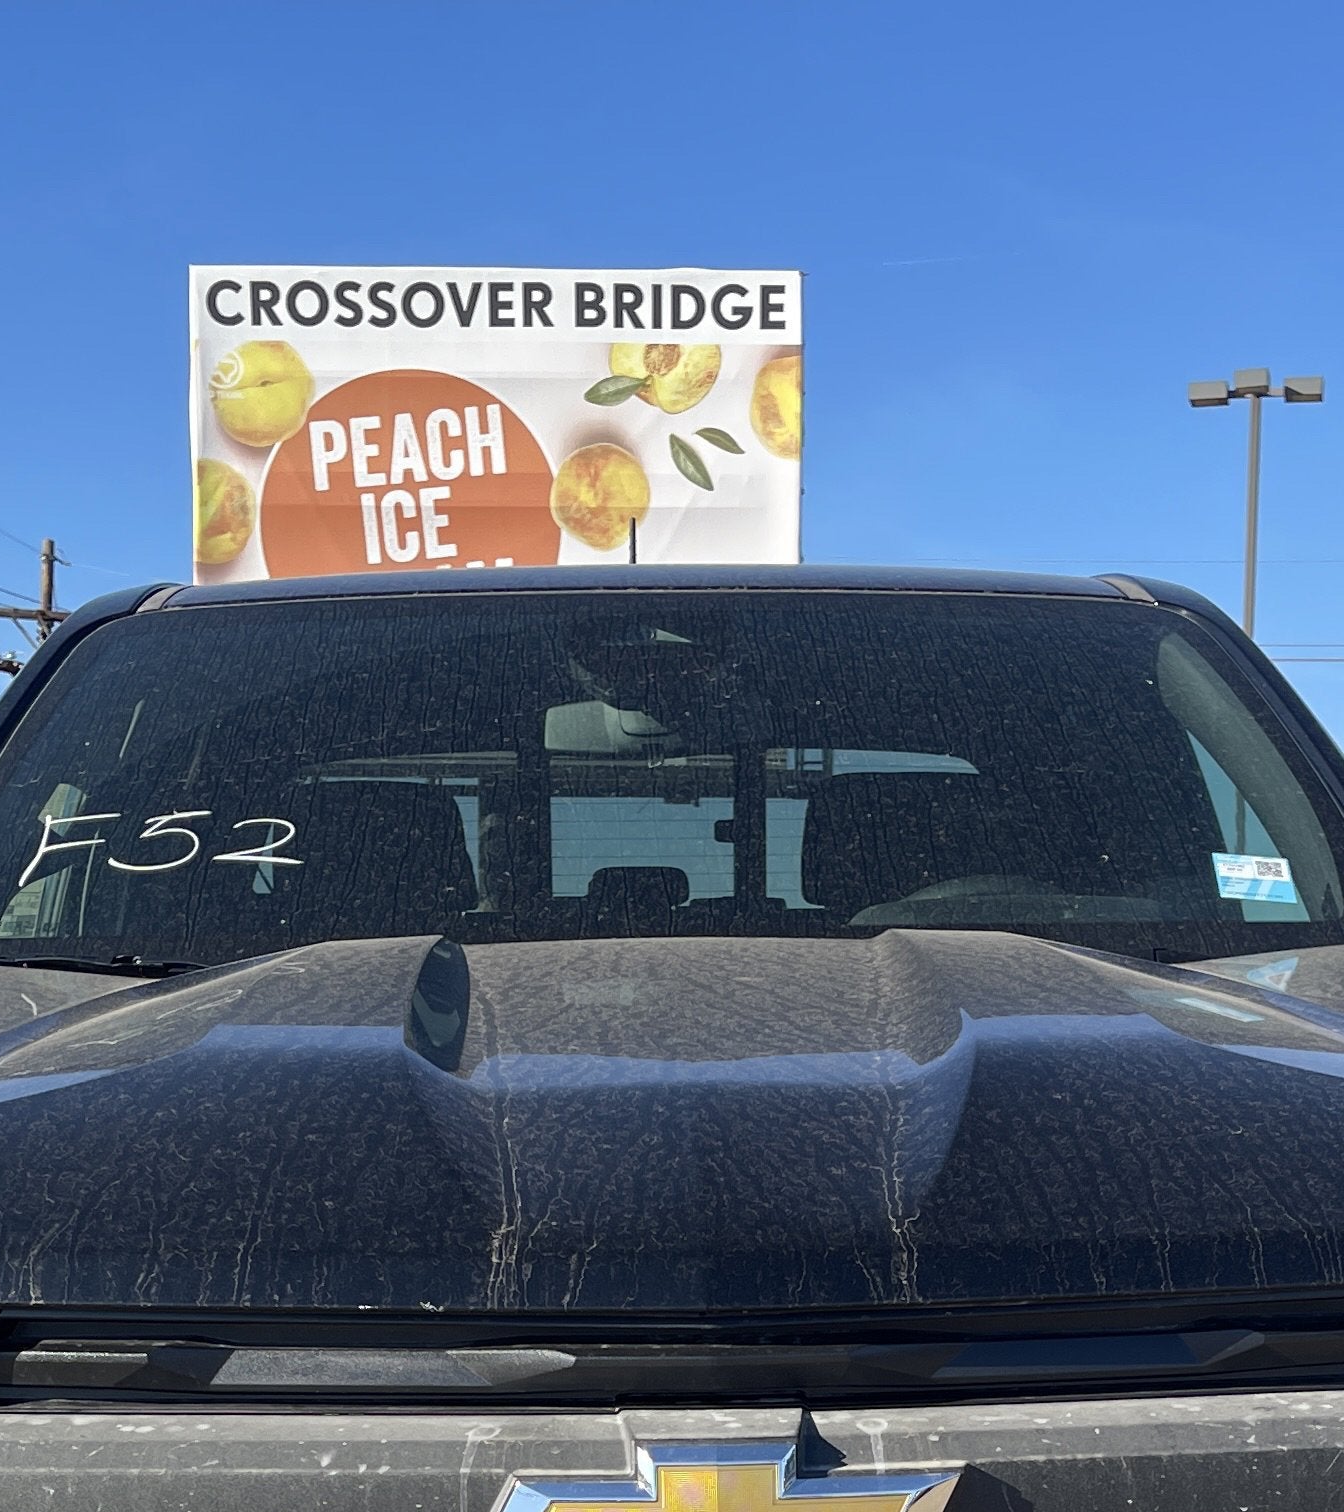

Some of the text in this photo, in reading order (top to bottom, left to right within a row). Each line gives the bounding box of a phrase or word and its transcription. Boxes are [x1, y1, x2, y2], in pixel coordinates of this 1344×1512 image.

[206, 279, 787, 330] CROSSOVER BRIDGE
[308, 403, 508, 492] PEACH
[359, 486, 458, 565] ICE
[18, 809, 305, 888] F52
